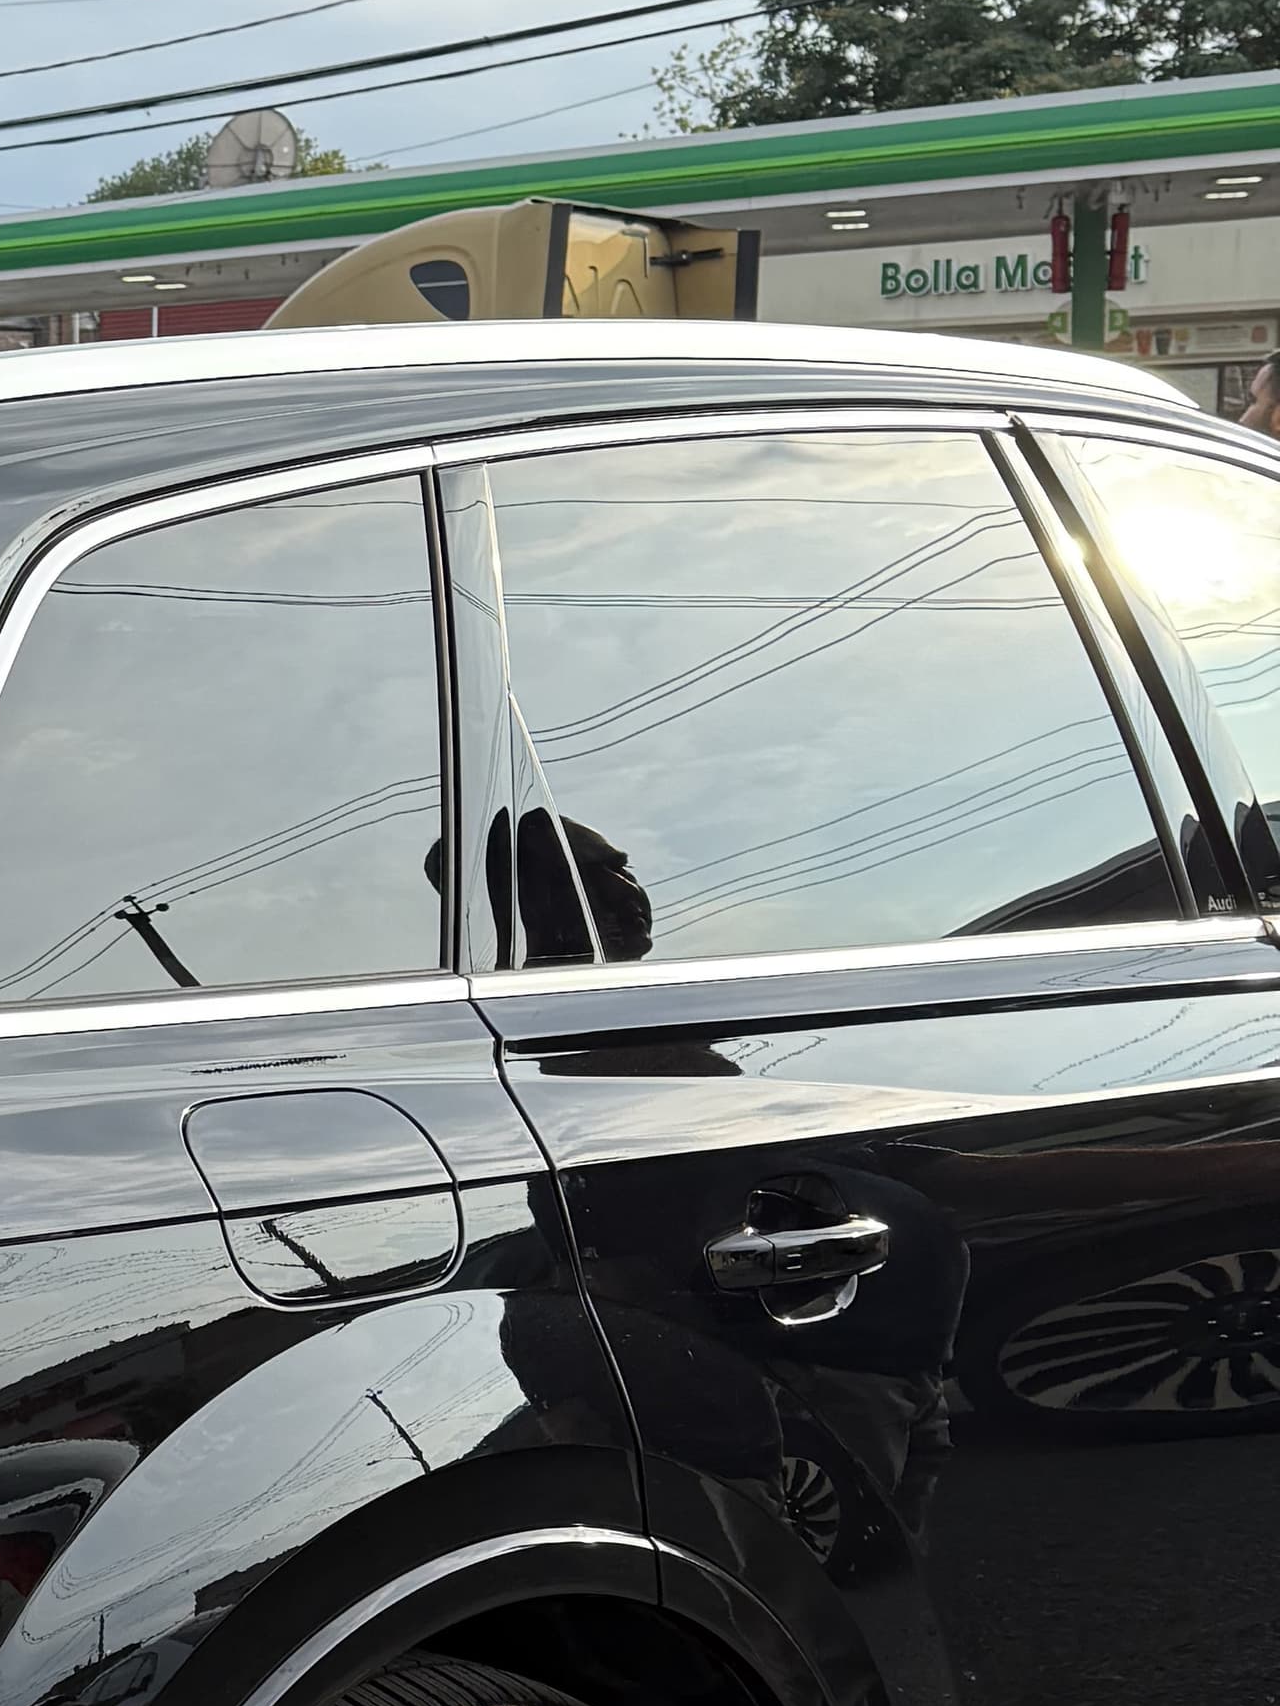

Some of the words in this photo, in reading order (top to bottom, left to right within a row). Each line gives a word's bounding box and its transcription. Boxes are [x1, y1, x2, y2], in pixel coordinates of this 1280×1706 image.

[880, 257, 981, 296] Bolla
[995, 245, 1148, 292] Mat
[1208, 893, 1238, 912] Audi
